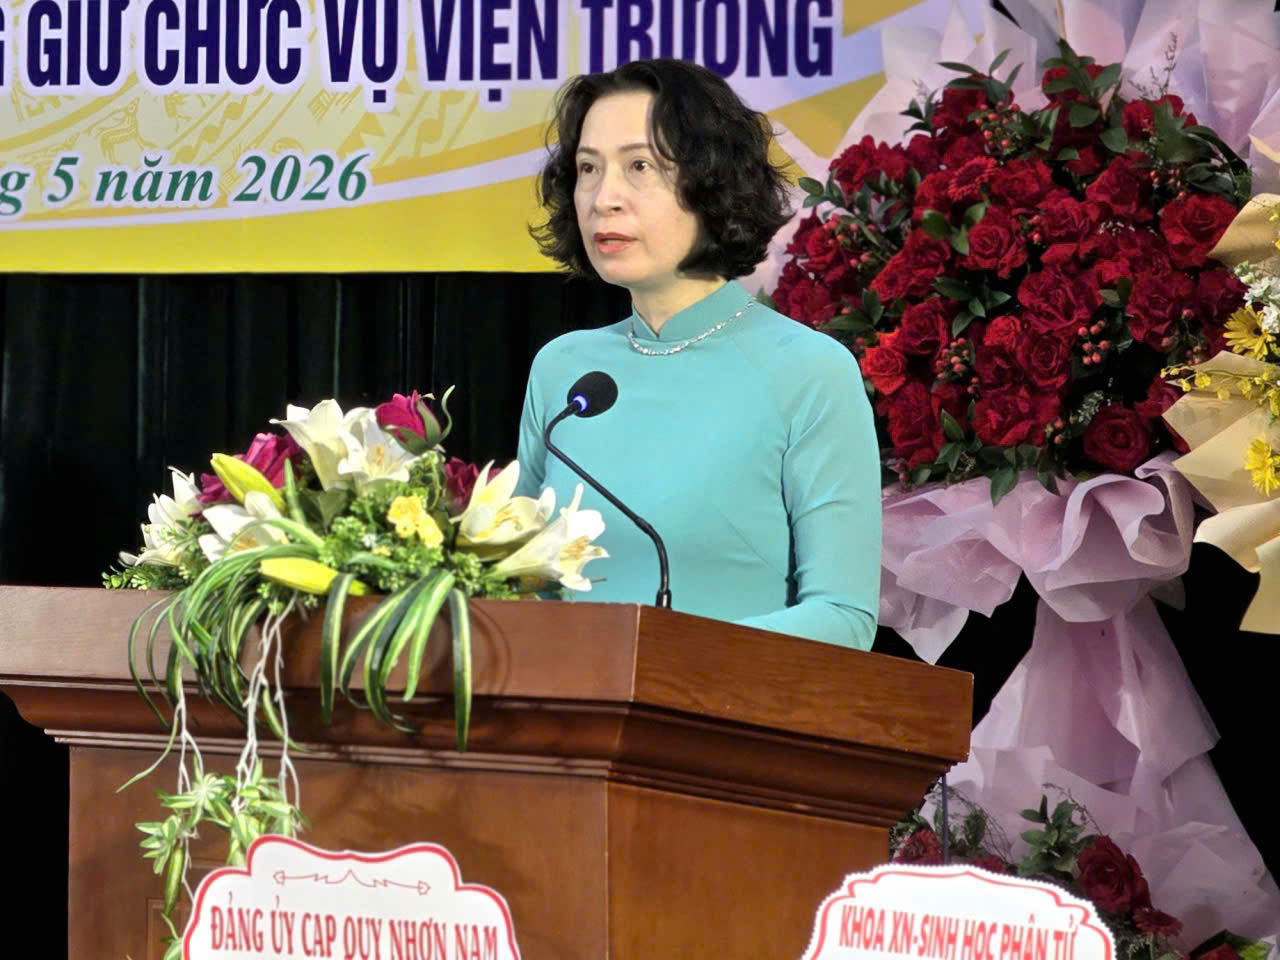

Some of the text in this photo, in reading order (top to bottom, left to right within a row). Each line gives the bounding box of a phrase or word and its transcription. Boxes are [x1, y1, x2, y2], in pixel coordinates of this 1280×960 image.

[48, 157, 78, 202] 5
[96, 157, 212, 201] năm
[234, 154, 368, 201] 2026
[210, 891, 264, 951] ĐẢNG
[389, 920, 447, 960] NHƠN
[455, 924, 497, 960] NAM
[840, 906, 885, 950] KHOA
[1000, 914, 1048, 960] PHÂN
